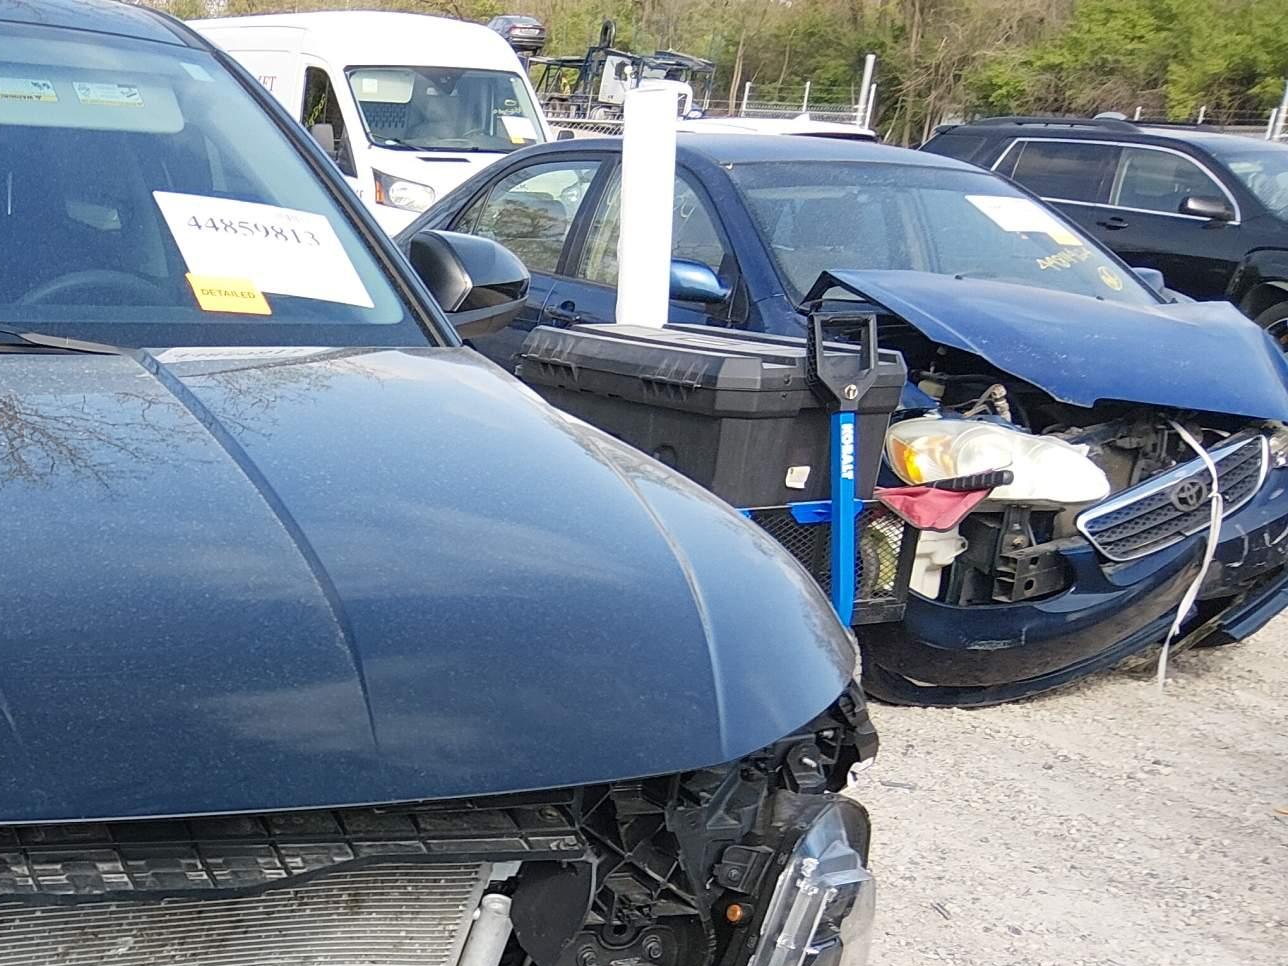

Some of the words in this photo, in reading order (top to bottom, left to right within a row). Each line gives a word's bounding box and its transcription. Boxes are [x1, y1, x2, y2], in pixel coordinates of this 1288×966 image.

[187, 215, 321, 246] 44859813
[200, 288, 256, 299] DETAILED
[840, 423, 855, 480] KOBALT
